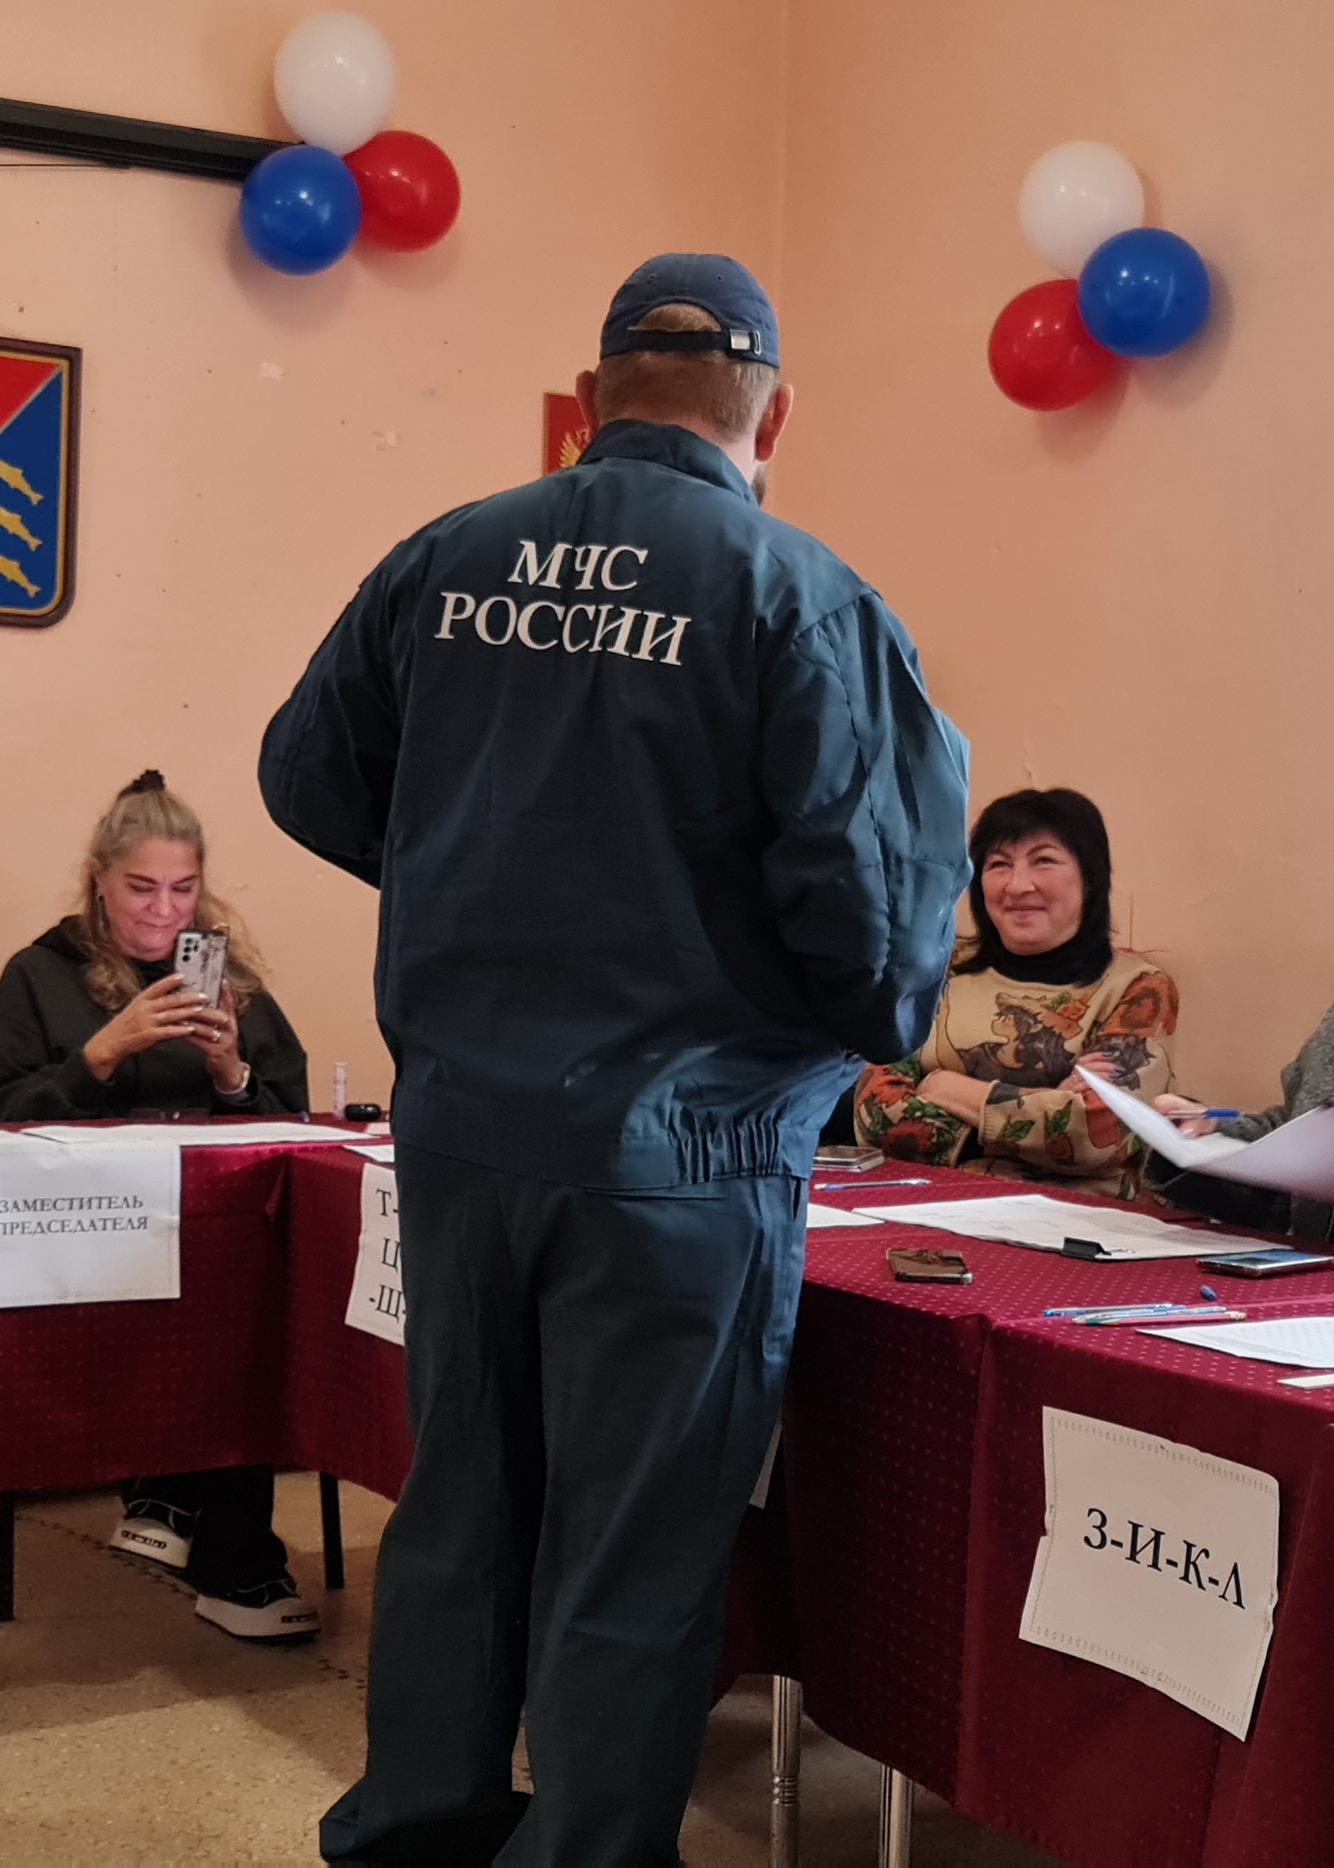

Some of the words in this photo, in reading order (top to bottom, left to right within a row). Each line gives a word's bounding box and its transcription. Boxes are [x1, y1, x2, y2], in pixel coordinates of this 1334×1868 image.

[507, 539, 649, 591] МЧС
[434, 591, 692, 666] РОССИИ
[1082, 1507, 1246, 1611] З-И-К-Л
